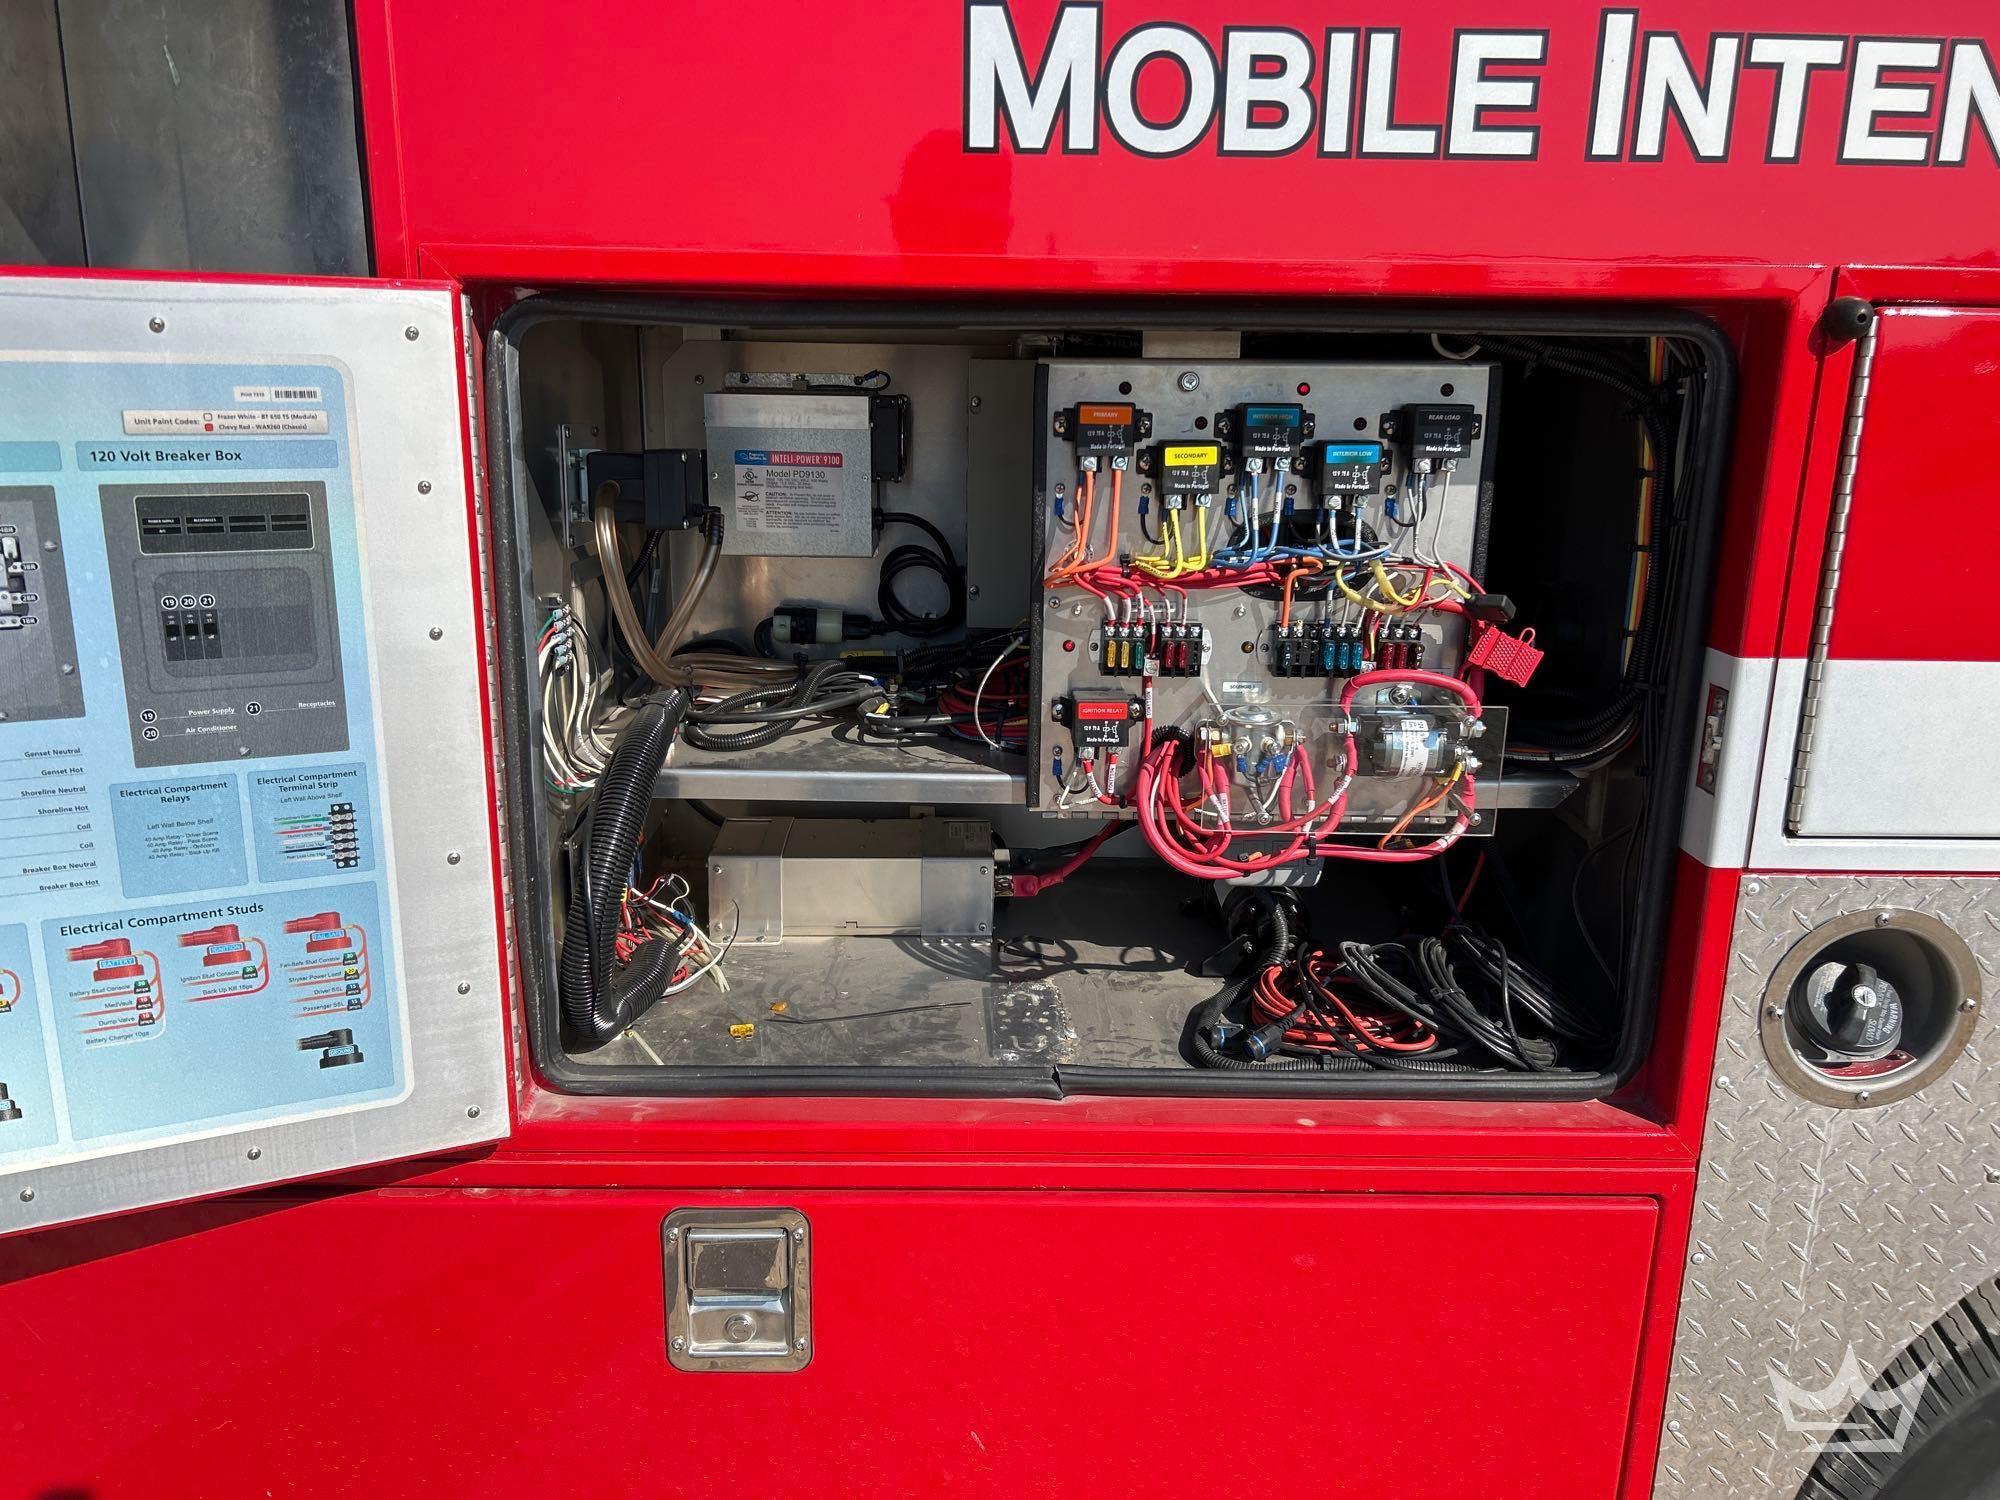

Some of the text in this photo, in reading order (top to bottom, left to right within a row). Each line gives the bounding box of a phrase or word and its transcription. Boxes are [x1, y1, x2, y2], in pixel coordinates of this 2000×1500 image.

[965, 2, 2000, 166] MOBILE INTEN
[90, 450, 242, 462] 120 Volt Breaker Box
[772, 454, 820, 464] INTELI-POWER
[823, 455, 840, 465] 9100
[766, 469, 791, 477] Model
[793, 470, 825, 479] PD9130
[298, 700, 335, 708] Receptacles
[212, 707, 235, 715] Supply
[197, 724, 237, 733] Conditioner
[257, 770, 357, 785] Electrical Compartment
[21, 789, 56, 797] Shoreline
[120, 781, 228, 797] Electrical Compartment
[278, 783, 316, 793] Terminal
[161, 794, 190, 803] Relays
[38, 806, 73, 814] Shoreline
[22, 866, 51, 874] Breaker
[69, 861, 96, 869] Neutral
[40, 883, 67, 891] Breaker
[60, 902, 264, 937] Electrical Compartment Studs
[1882, 1003, 1898, 1034] WARNING
